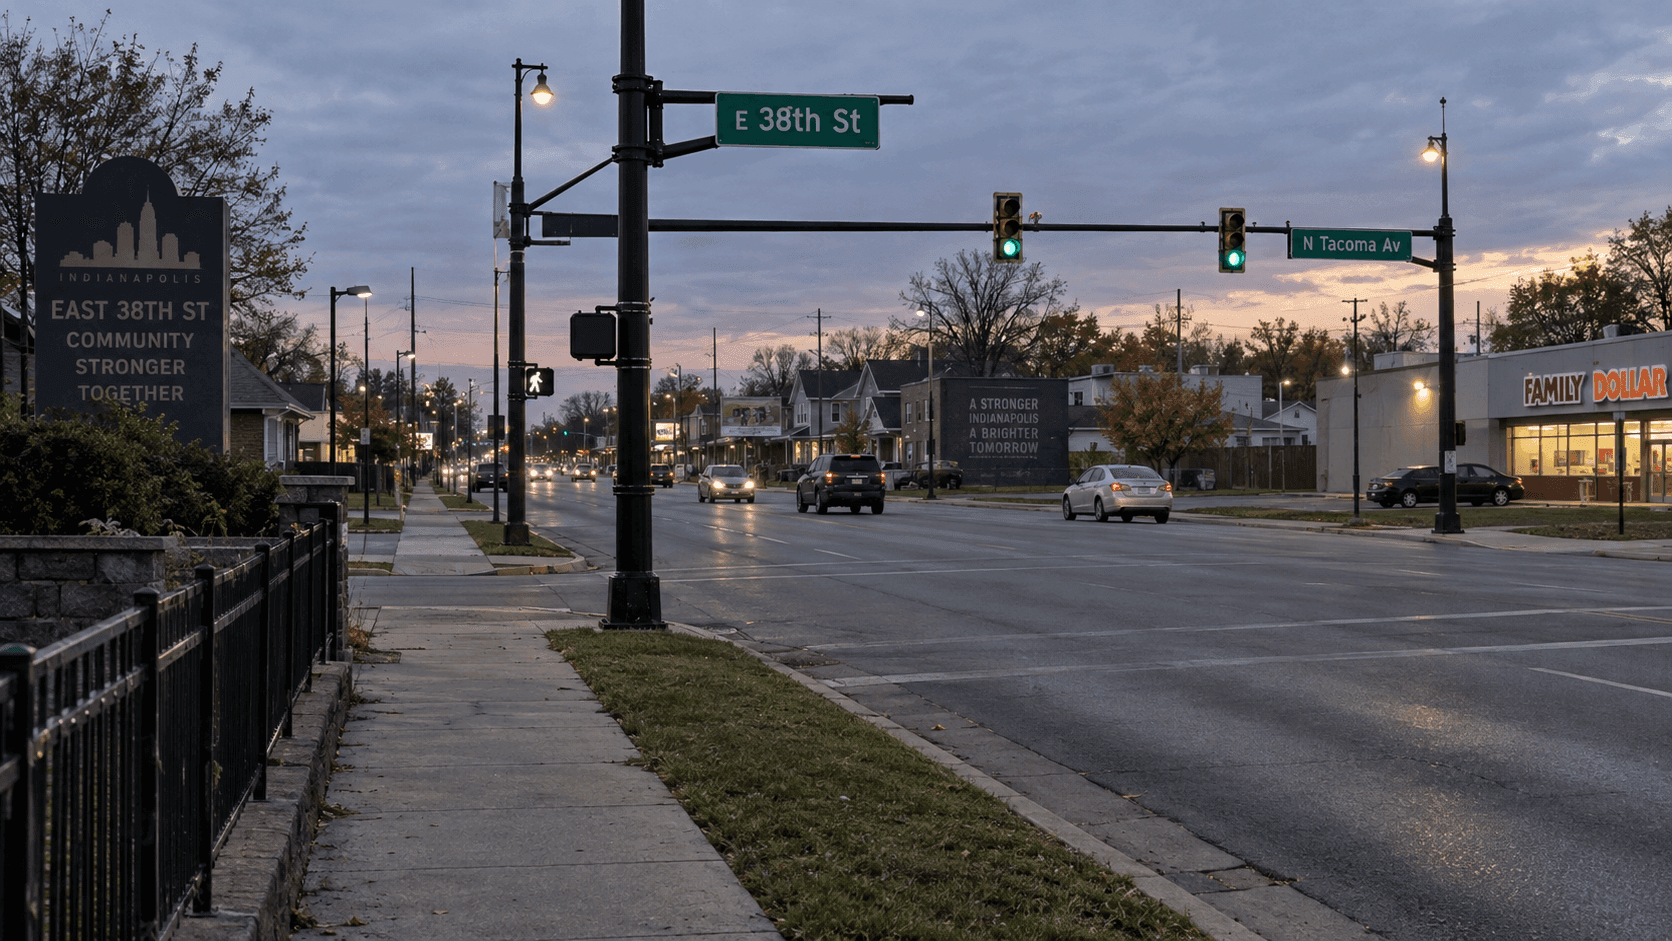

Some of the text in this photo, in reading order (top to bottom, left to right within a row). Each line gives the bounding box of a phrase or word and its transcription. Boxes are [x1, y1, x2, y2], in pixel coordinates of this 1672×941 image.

[736, 106, 861, 133] E 38th St
[1303, 235, 1401, 253] N Tacoma Av
[59, 272, 201, 284] INDIANAPOLIS
[51, 299, 210, 321] EAST 38TH ST
[66, 331, 195, 349] COMMUNITY
[75, 357, 186, 375] STRONGER
[78, 384, 184, 402] TOGETHER
[1524, 364, 1668, 406] FAMILY DOLLAR
[969, 398, 1039, 410] A STRONGER
[969, 413, 1039, 424] INDIANAPOLIS
[969, 427, 1039, 439] A BRIGHTER
[969, 441, 1039, 454] TOMORROW
